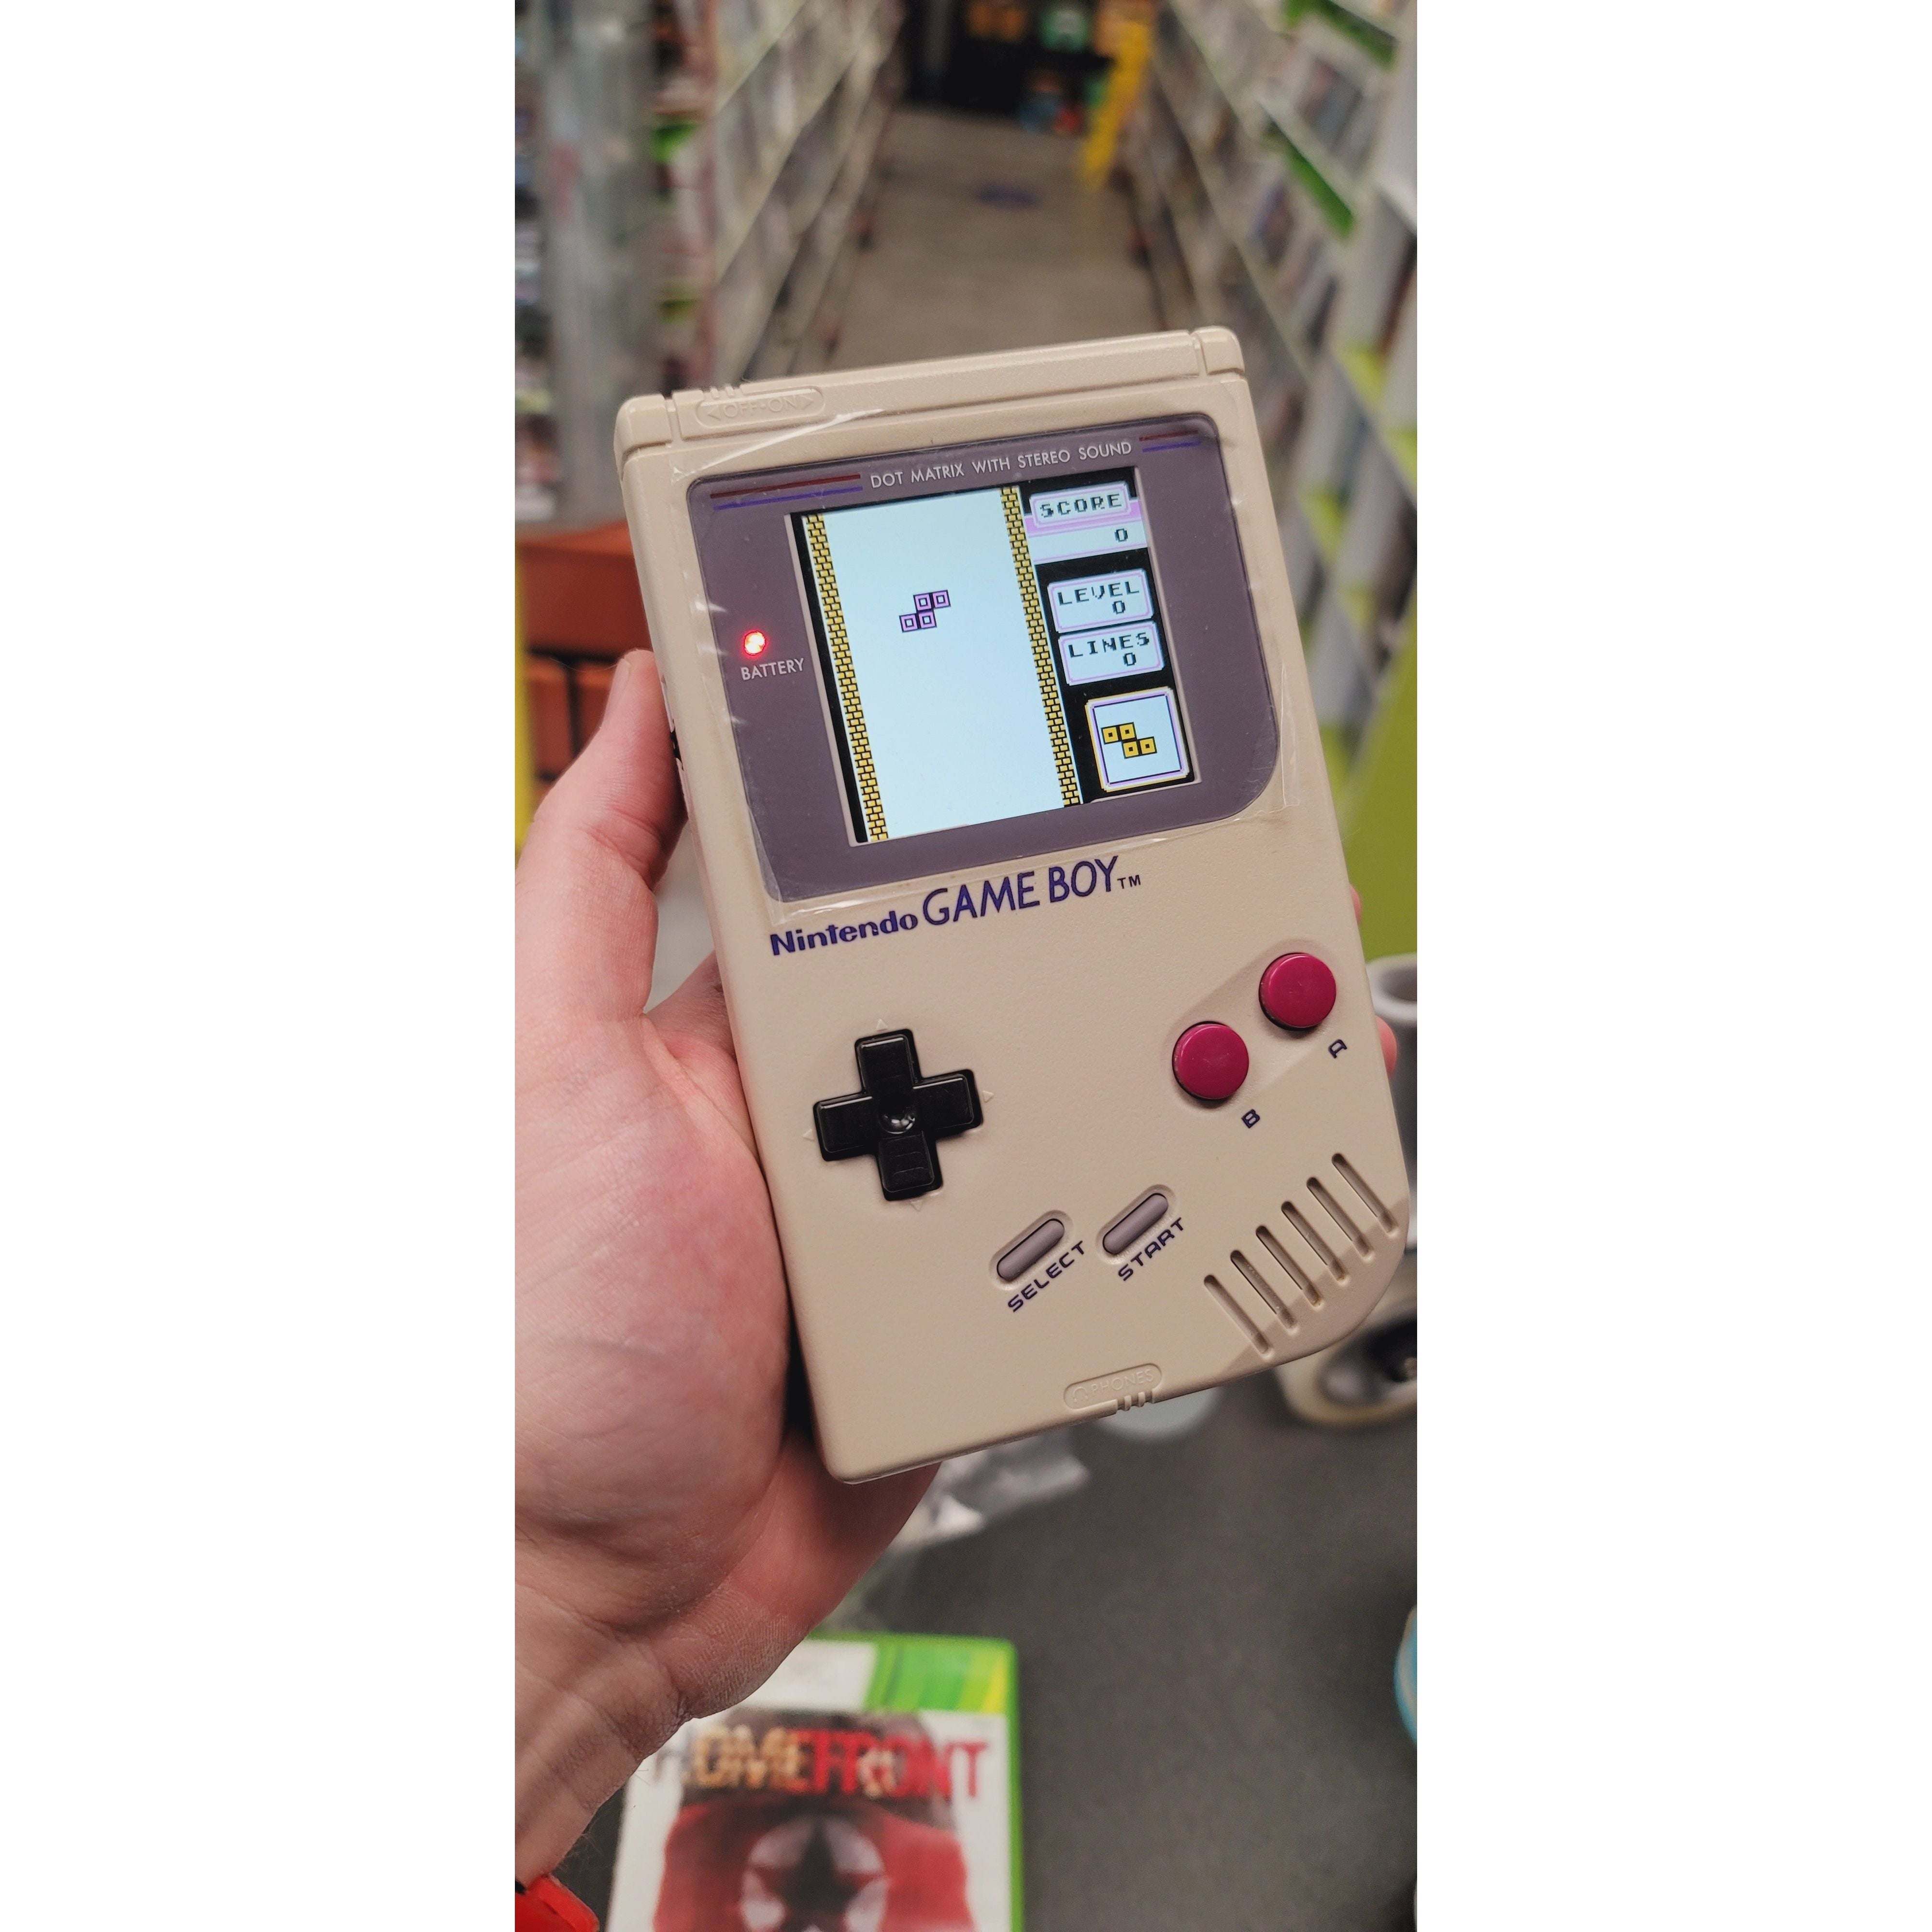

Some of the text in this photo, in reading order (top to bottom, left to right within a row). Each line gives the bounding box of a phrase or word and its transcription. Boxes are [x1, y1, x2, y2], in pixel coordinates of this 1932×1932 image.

[870, 441, 1132, 489] DOT MATRIX WITH STEREO SOUND
[1039, 493, 1122, 518] SCORE
[1057, 581, 1140, 606] LEVEL
[1067, 632, 1150, 658] LINES
[740, 658, 804, 681] BATTERY
[770, 910, 919, 956] Nintendo
[923, 870, 1040, 926] GAME
[1049, 855, 1119, 904] BOY
[1328, 1039, 1348, 1059] A
[1241, 1109, 1260, 1129] B
[1118, 1217, 1184, 1282] START
[1008, 1240, 1085, 1313] SELECT
[1091, 1368, 1154, 1392] PHONES
